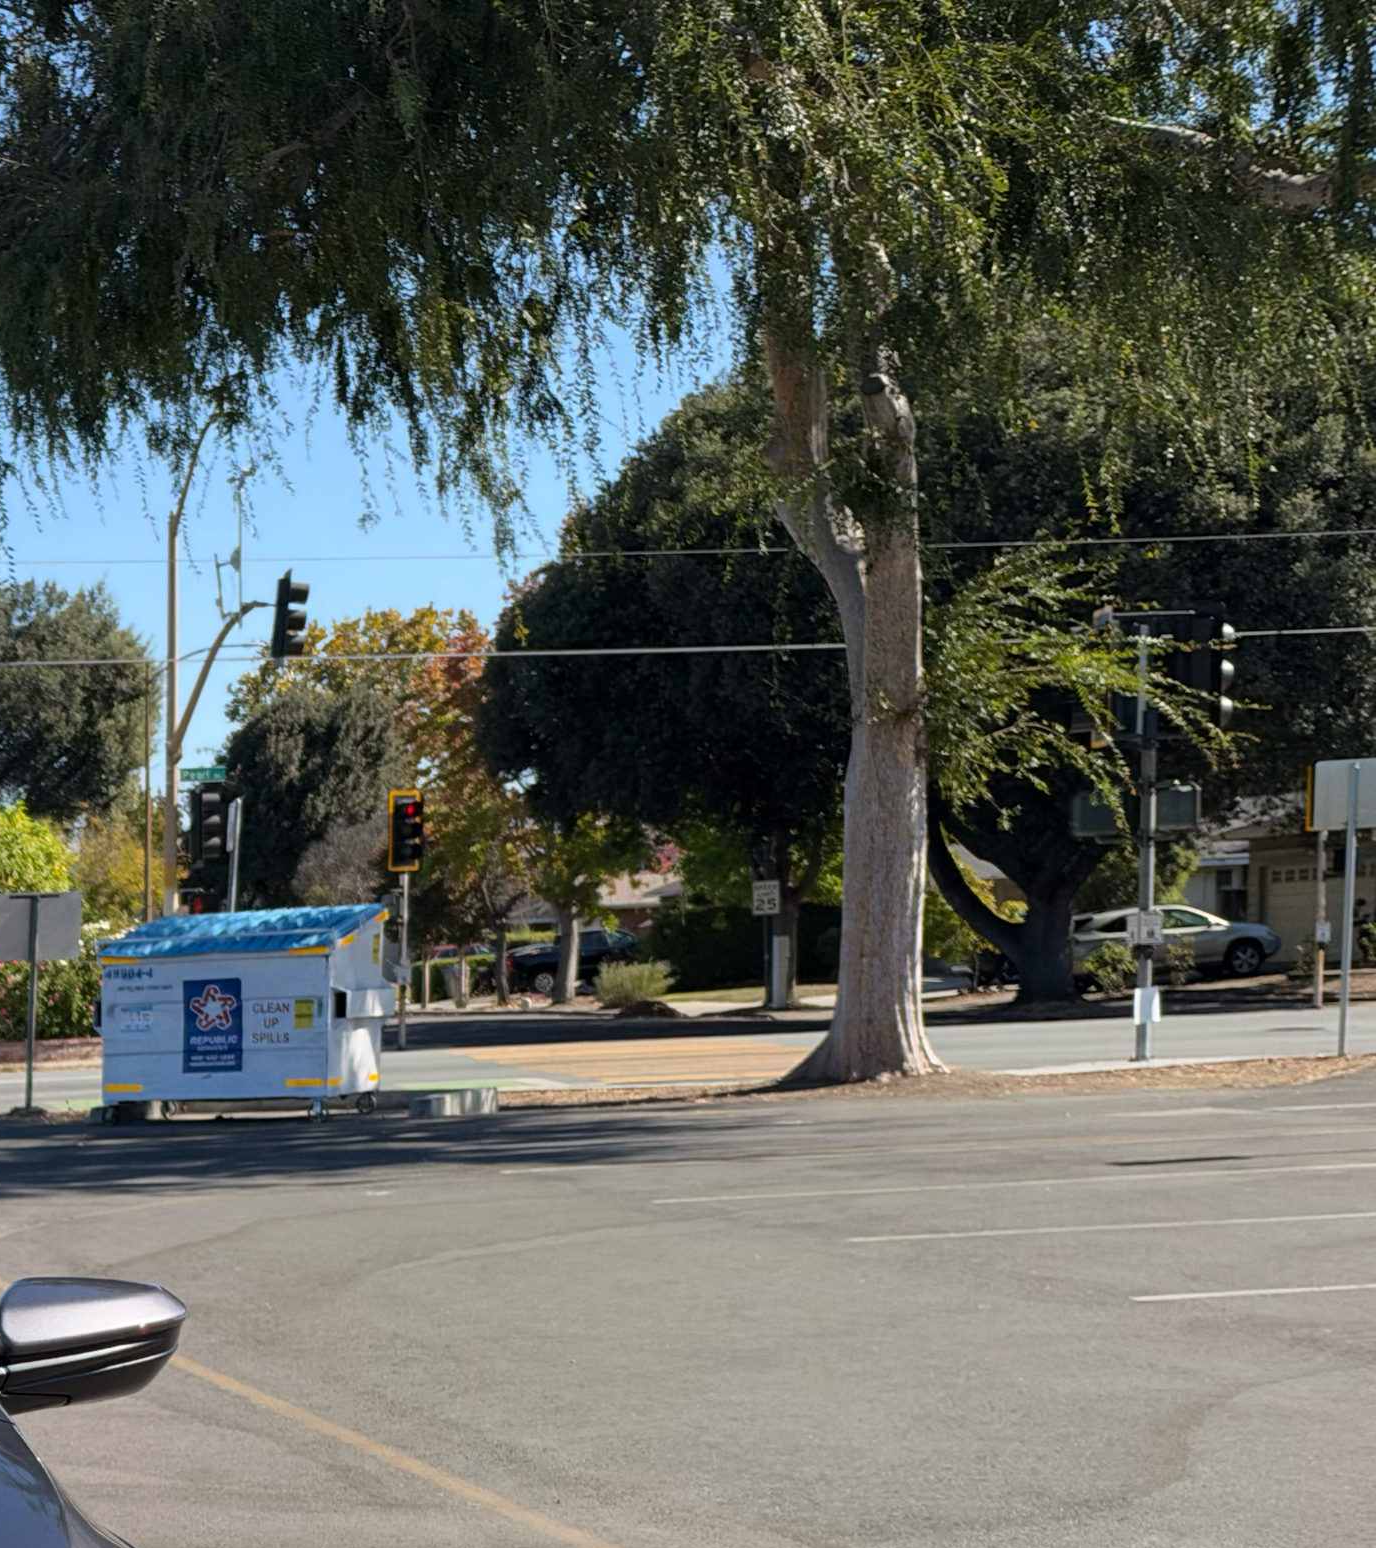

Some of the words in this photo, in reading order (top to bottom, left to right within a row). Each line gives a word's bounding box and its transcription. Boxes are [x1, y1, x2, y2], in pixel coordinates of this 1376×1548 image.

[182, 770, 210, 780] Pearl
[755, 898, 777, 911] 25
[252, 1001, 290, 1014] CLEAN
[263, 1017, 279, 1028] UP
[189, 1034, 238, 1046] REPUBLIC
[252, 1032, 290, 1044] SPILLS
